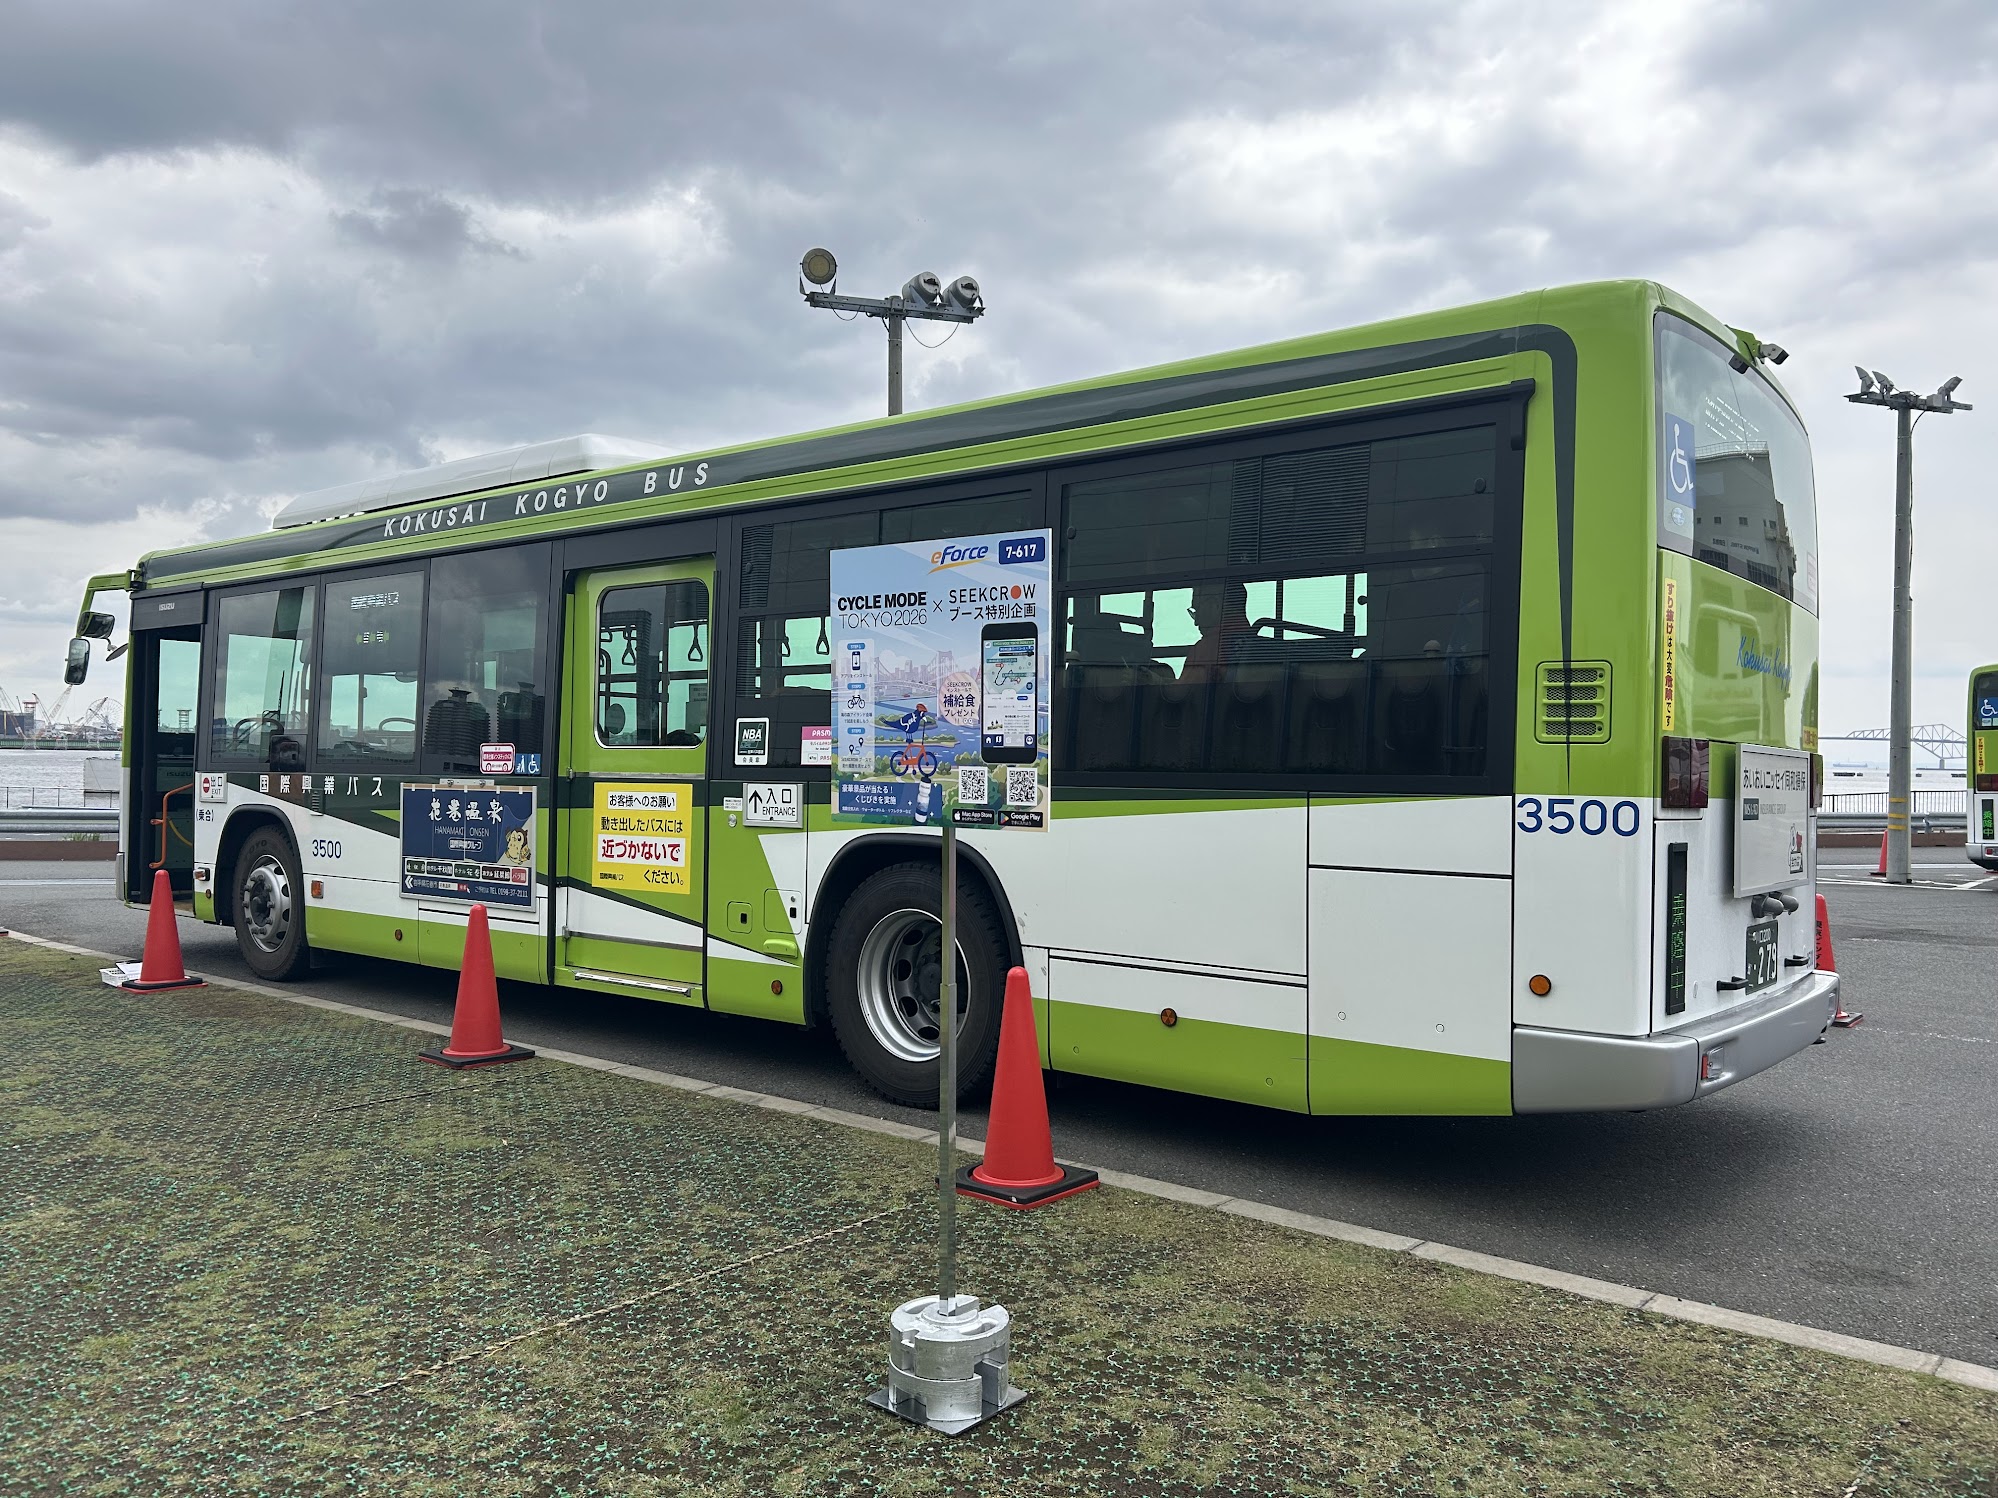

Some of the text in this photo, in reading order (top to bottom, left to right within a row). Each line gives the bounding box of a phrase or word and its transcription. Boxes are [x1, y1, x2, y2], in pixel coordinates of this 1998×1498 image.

[384, 462, 709, 537] KOKUSAI KOGYO BUS
[930, 545, 989, 565] eForce
[1005, 544, 1037, 559] 7-617
[837, 592, 927, 611] CYCLE MODE
[949, 584, 1036, 604] SEEKCROW
[158, 602, 175, 611] ISUZU
[949, 603, 1036, 622] ブース特別企画
[1664, 582, 1675, 727] すり抜けは大変危険です
[1737, 635, 1772, 675] Kokusai
[943, 693, 975, 708] 補給食
[944, 709, 975, 717] プレゼント
[742, 729, 762, 740] NBA
[210, 776, 223, 788] 出口
[259, 775, 383, 797] 国際興業バス
[1743, 766, 1806, 791] あいおいニッセイ同和損保
[609, 794, 675, 808] お客様へのお願い
[766, 788, 791, 804] 入口
[428, 797, 503, 825] 花巻温泉
[762, 806, 796, 817] ENTRANCE
[1010, 812, 1041, 822] Google Play
[1517, 797, 1640, 837] 3500
[434, 825, 490, 837] HANAMAKI ONSEN
[600, 816, 683, 833] 動き出したバスには
[312, 839, 342, 859] 3500
[602, 839, 681, 862] 近づかないで
[643, 869, 684, 886] ください。
[489, 886, 498, 895] TEL
